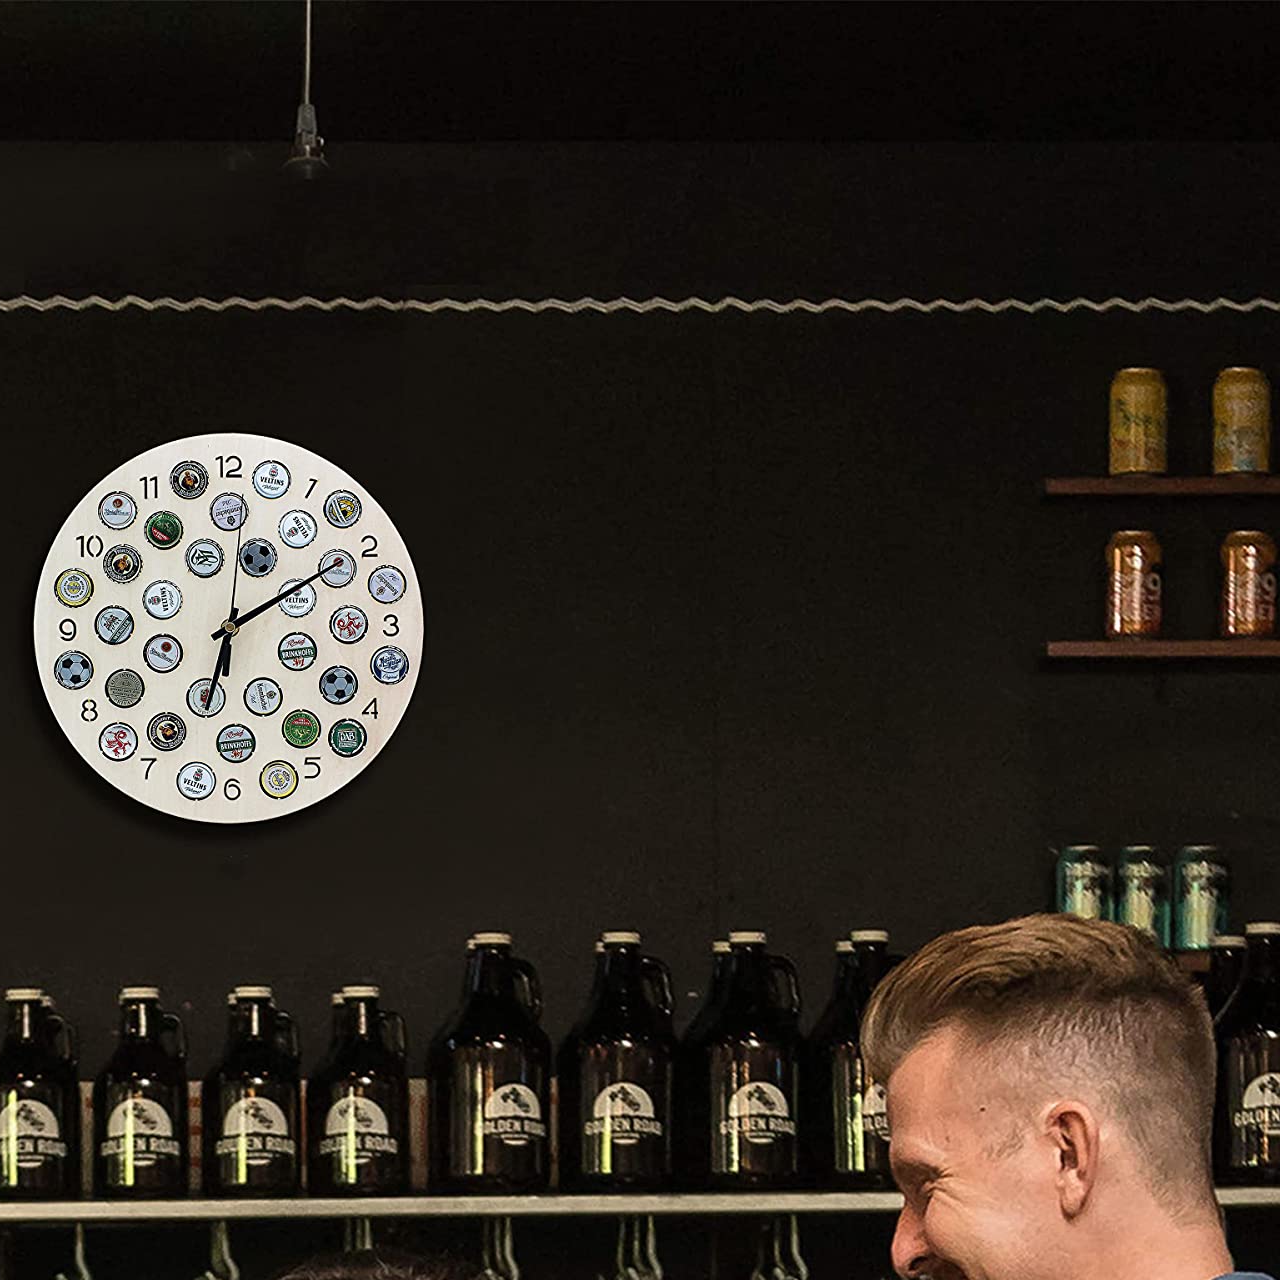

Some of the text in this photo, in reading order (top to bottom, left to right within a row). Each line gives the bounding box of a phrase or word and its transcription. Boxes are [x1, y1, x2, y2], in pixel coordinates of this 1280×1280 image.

[215, 455, 242, 478] 12
[139, 476, 158, 500] 11
[260, 476, 284, 486] VELTINS
[304, 478, 318, 499] 1
[292, 516, 309, 539] VELTINS
[75, 535, 104, 558] 10
[361, 535, 378, 558] 2
[159, 587, 169, 612] VELTINS
[59, 618, 77, 641] 9
[382, 614, 400, 637] 3
[81, 699, 98, 722] 8
[361, 697, 379, 719] 4
[140, 757, 157, 780] 7
[304, 756, 321, 779] 5
[183, 777, 207, 791] VELTINS
[223, 778, 241, 801] 6
